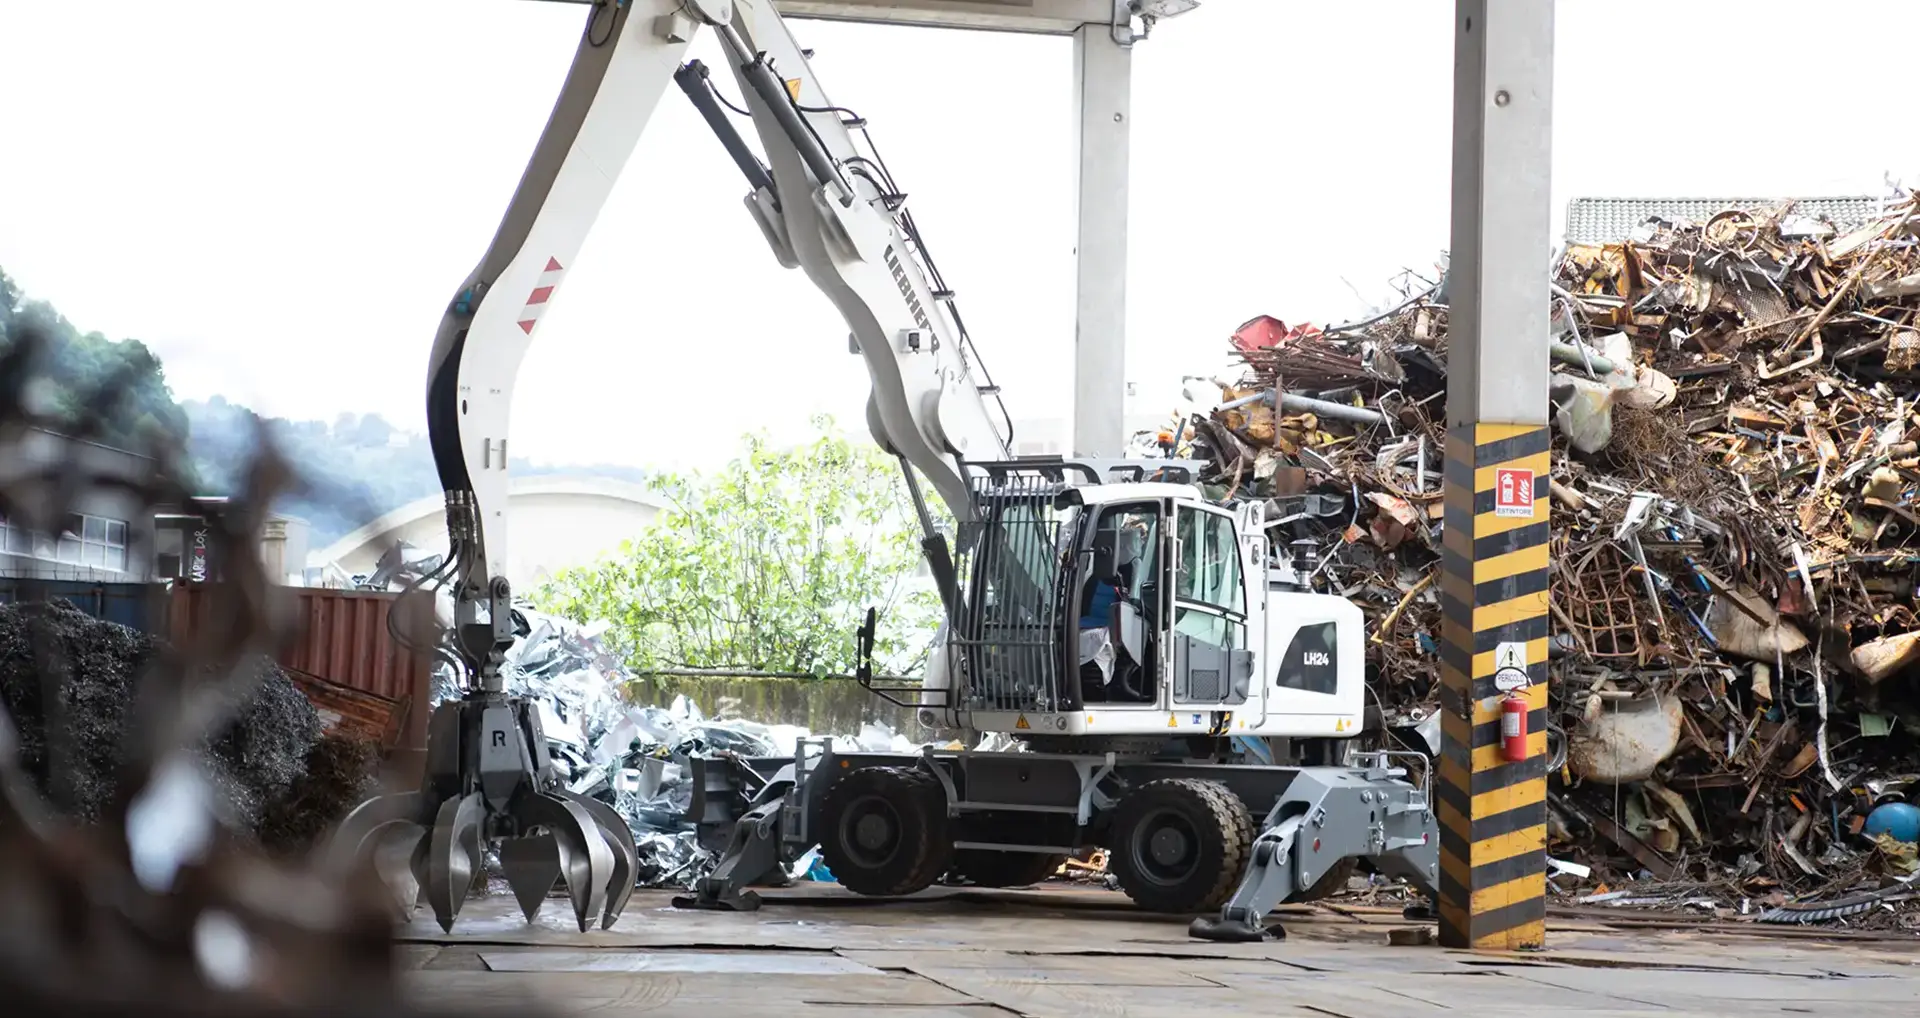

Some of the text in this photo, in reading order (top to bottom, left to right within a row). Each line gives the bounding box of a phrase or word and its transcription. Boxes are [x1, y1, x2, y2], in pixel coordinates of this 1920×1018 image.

[1497, 507, 1532, 515] ESTINTORE
[1303, 652, 1329, 666] LH24
[1498, 673, 1524, 682] PERICOLO
[492, 730, 506, 747] R
